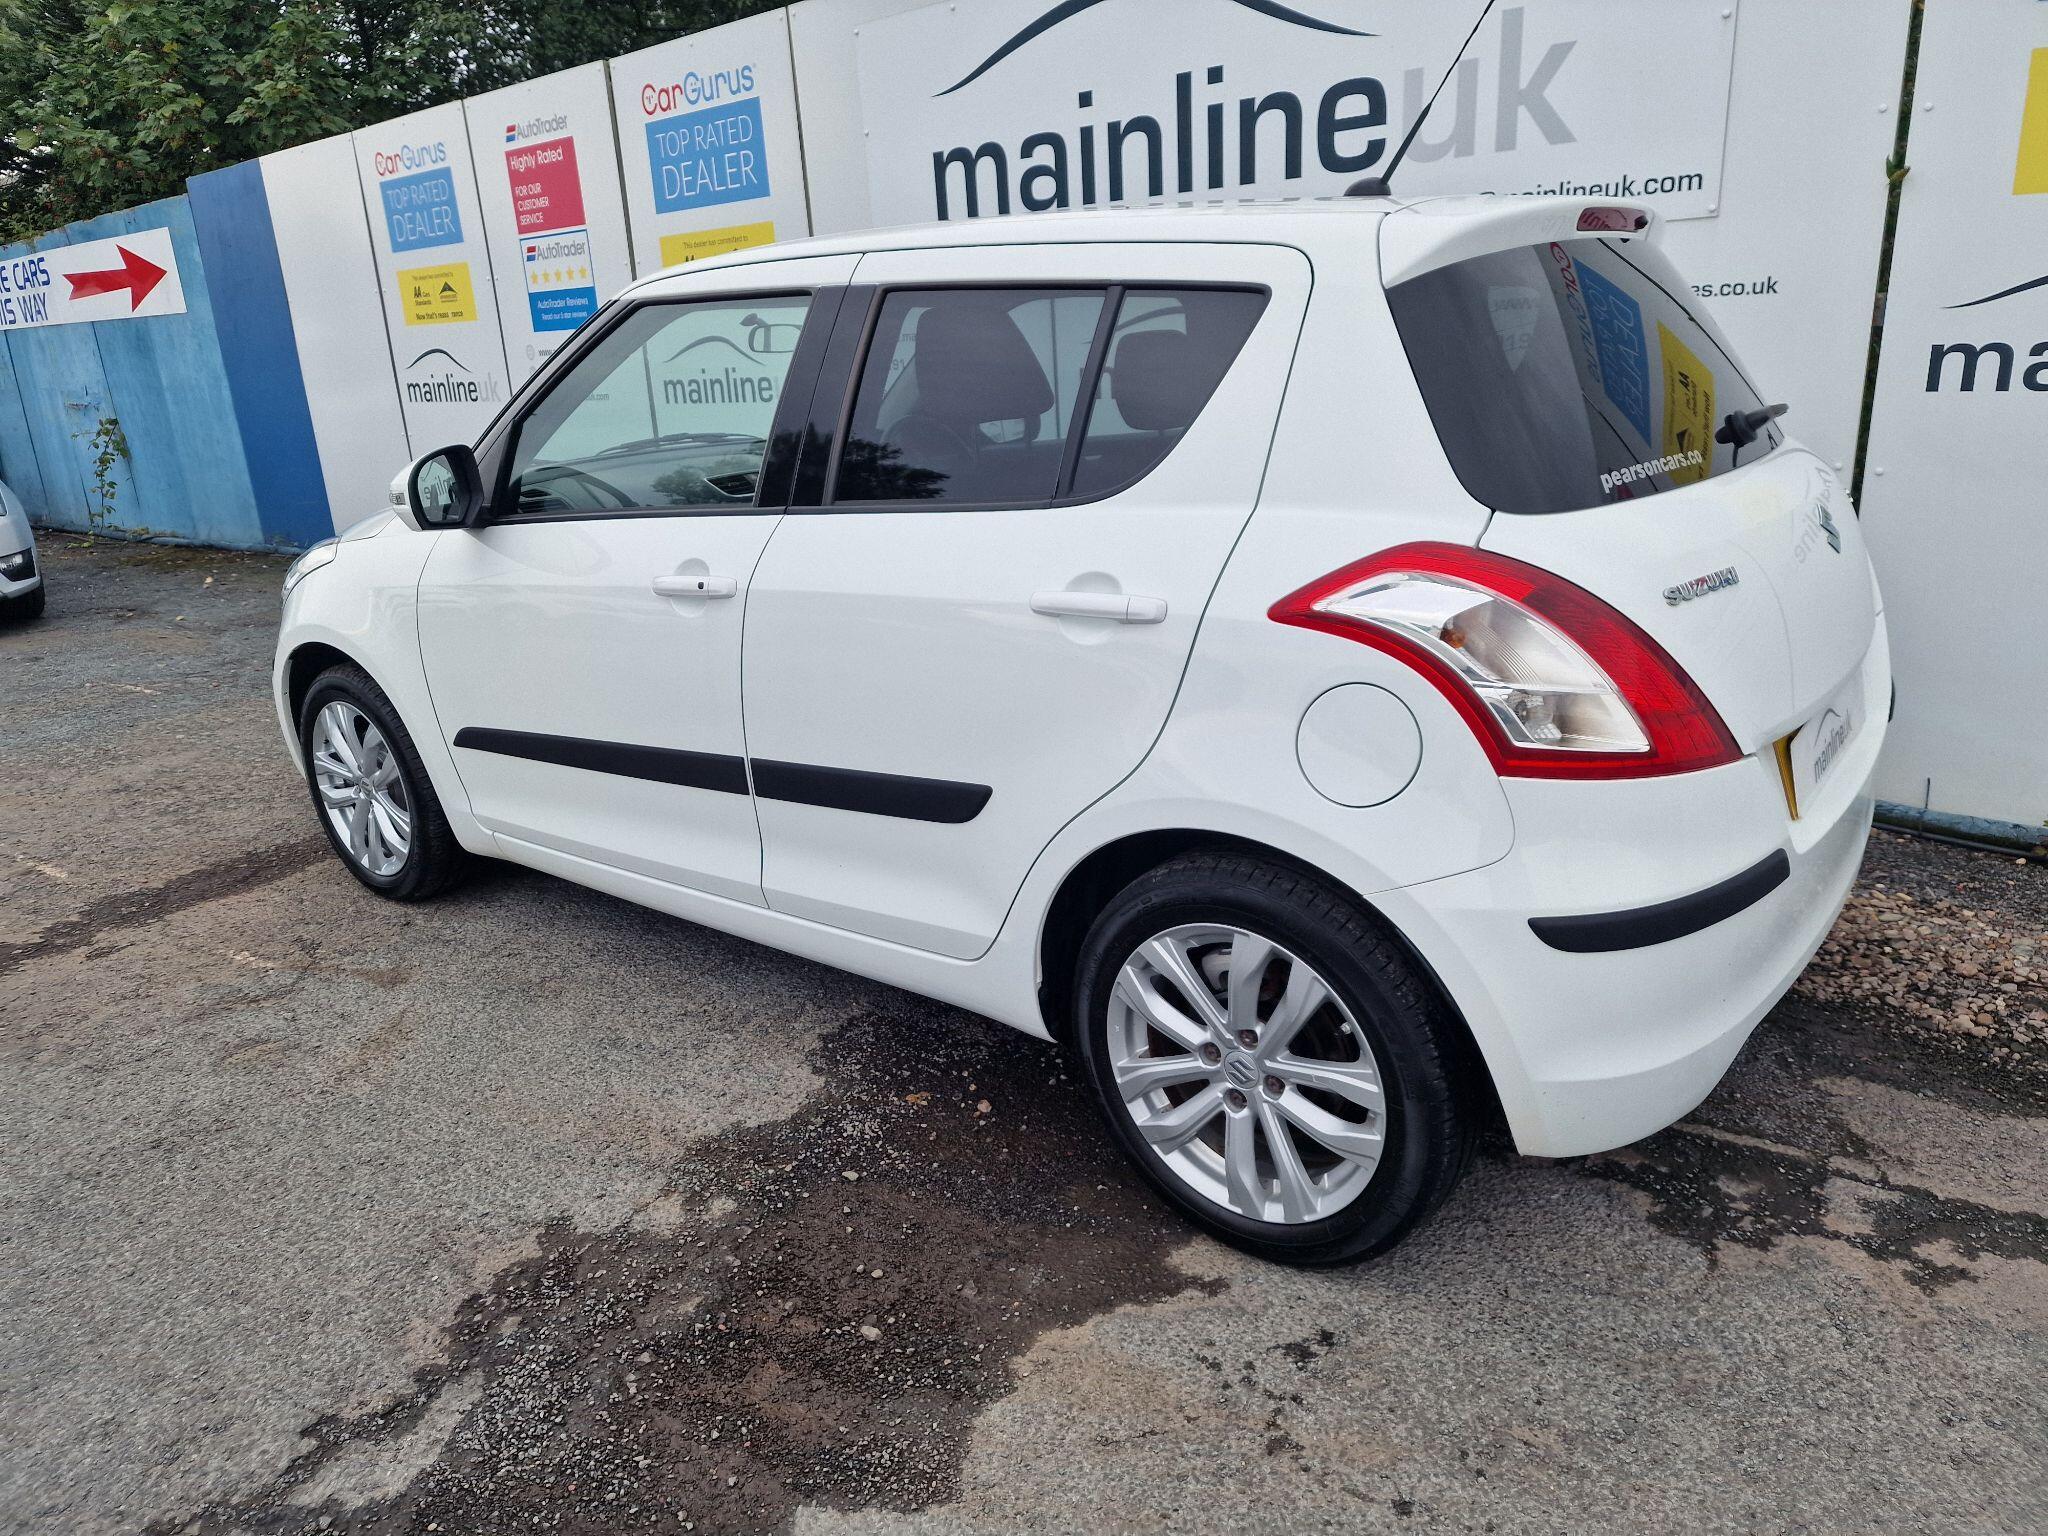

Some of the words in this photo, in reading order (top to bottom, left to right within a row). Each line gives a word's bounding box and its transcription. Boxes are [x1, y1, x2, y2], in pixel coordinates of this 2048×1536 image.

[641, 64, 755, 116] CarGurus
[517, 112, 568, 140] AutoTrader
[655, 128, 690, 159] TOP
[695, 115, 753, 150] RATED
[375, 142, 447, 177] CarGurus
[510, 152, 536, 172] Highly
[536, 145, 564, 165] Rated
[662, 150, 758, 200] DEALER
[387, 187, 408, 209] TOP
[409, 179, 449, 206] RATED
[515, 185, 528, 197] FOR
[528, 182, 542, 195] OUR
[517, 196, 550, 211] CUSTOMER
[393, 205, 456, 242] DEALER
[520, 212, 544, 225] SERVICE
[537, 240, 586, 261] AutoTrader
[13, 256, 51, 290] CARS
[17, 292, 49, 323] WAY
[664, 367, 780, 404] mainline
[1600, 449, 1703, 494] pearsoncars.co
[1663, 566, 1740, 606] SUZUKI
